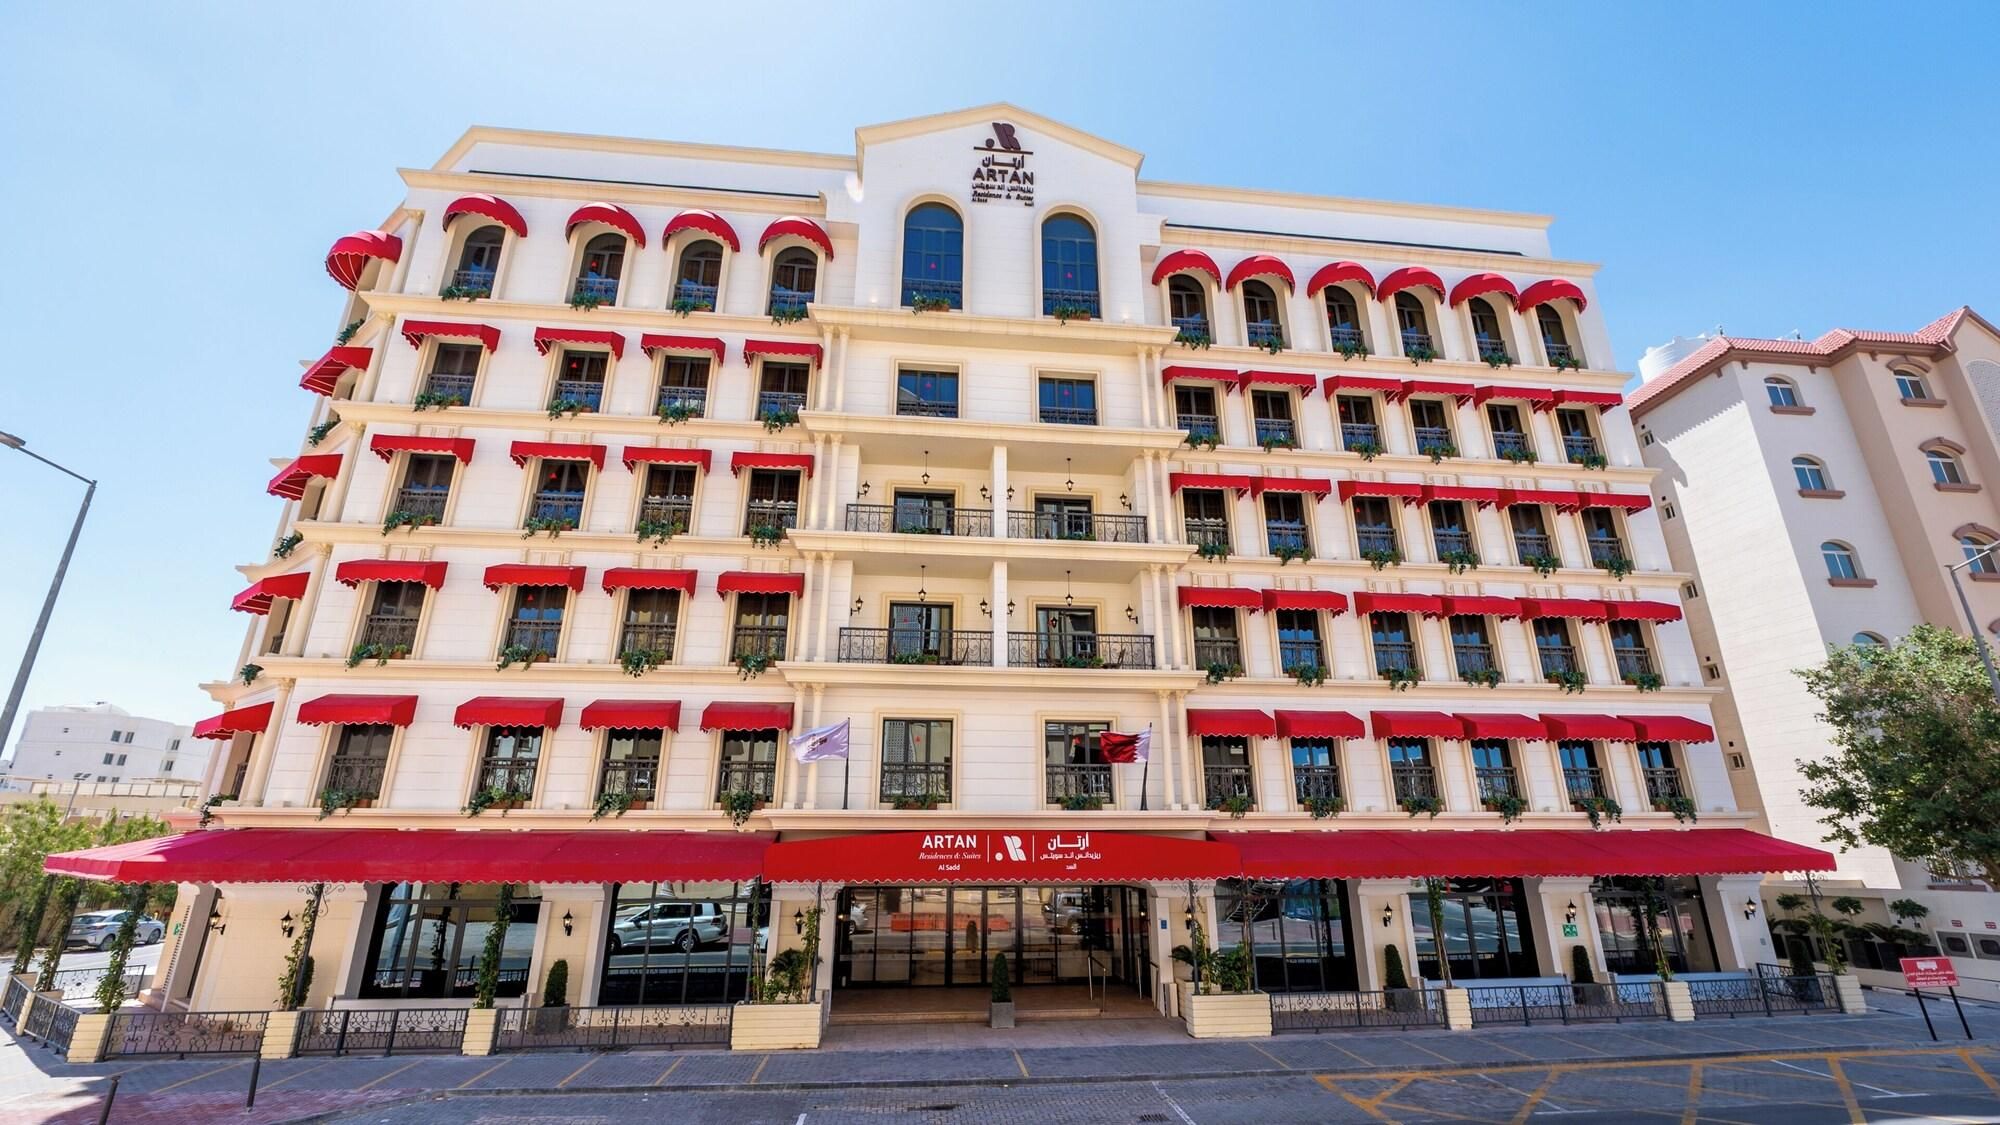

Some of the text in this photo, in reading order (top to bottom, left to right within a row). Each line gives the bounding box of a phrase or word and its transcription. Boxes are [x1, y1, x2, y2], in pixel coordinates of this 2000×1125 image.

[972, 167, 1034, 185] ARTAN
[922, 834, 977, 849] ARTAN
[918, 852, 953, 860] Residences
[961, 852, 982, 860] Suites
